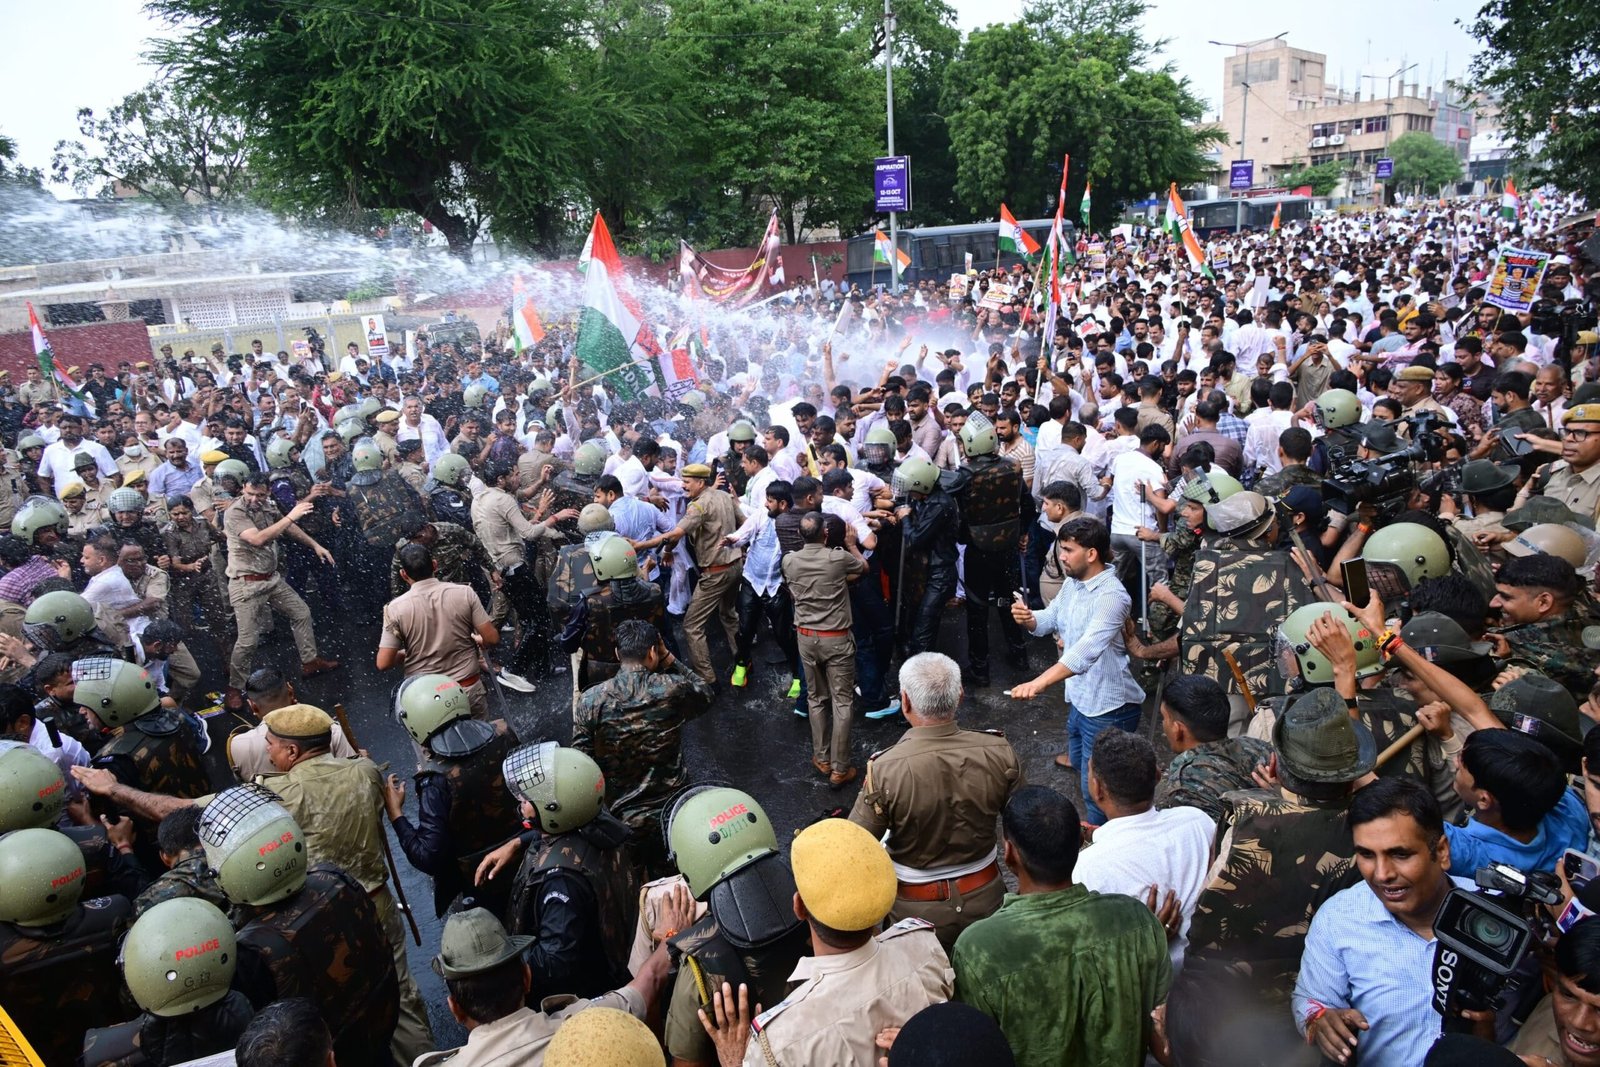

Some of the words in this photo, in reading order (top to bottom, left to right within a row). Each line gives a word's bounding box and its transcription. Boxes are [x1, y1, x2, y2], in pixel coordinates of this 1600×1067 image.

[876, 163, 905, 171] ASPIRATION
[710, 803, 749, 830] POLICE
[258, 831, 294, 857] POLICE
[51, 866, 84, 890] POLICE
[175, 937, 221, 961] POLICE
[1436, 949, 1458, 1012] SONY
